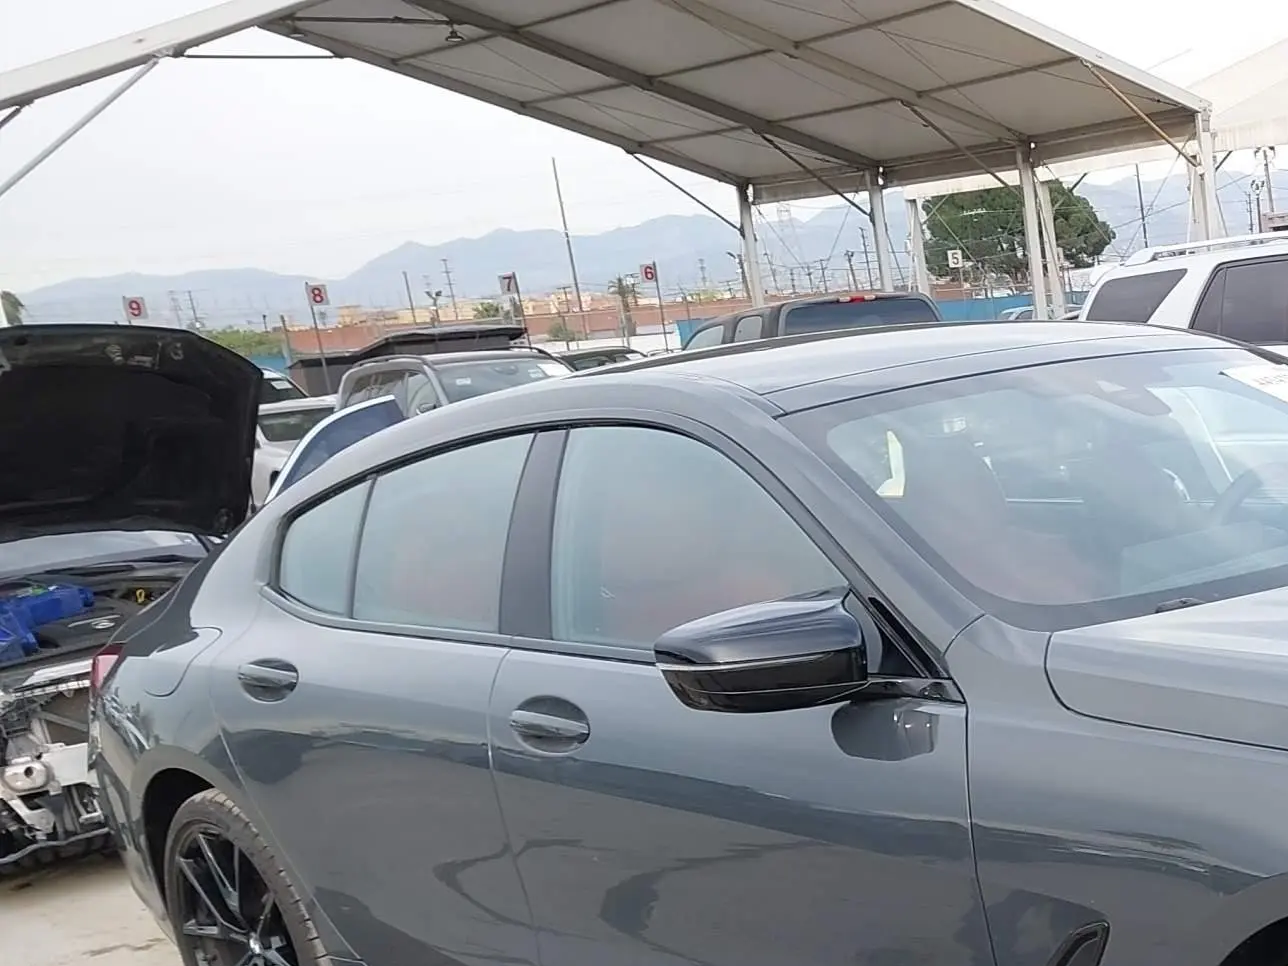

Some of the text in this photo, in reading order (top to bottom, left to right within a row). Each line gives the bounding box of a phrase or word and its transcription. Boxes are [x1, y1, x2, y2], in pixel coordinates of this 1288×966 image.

[951, 252, 960, 265] 5
[644, 265, 655, 281] 6
[502, 276, 513, 292] 7
[311, 287, 324, 304] 8
[128, 300, 142, 317] 9
